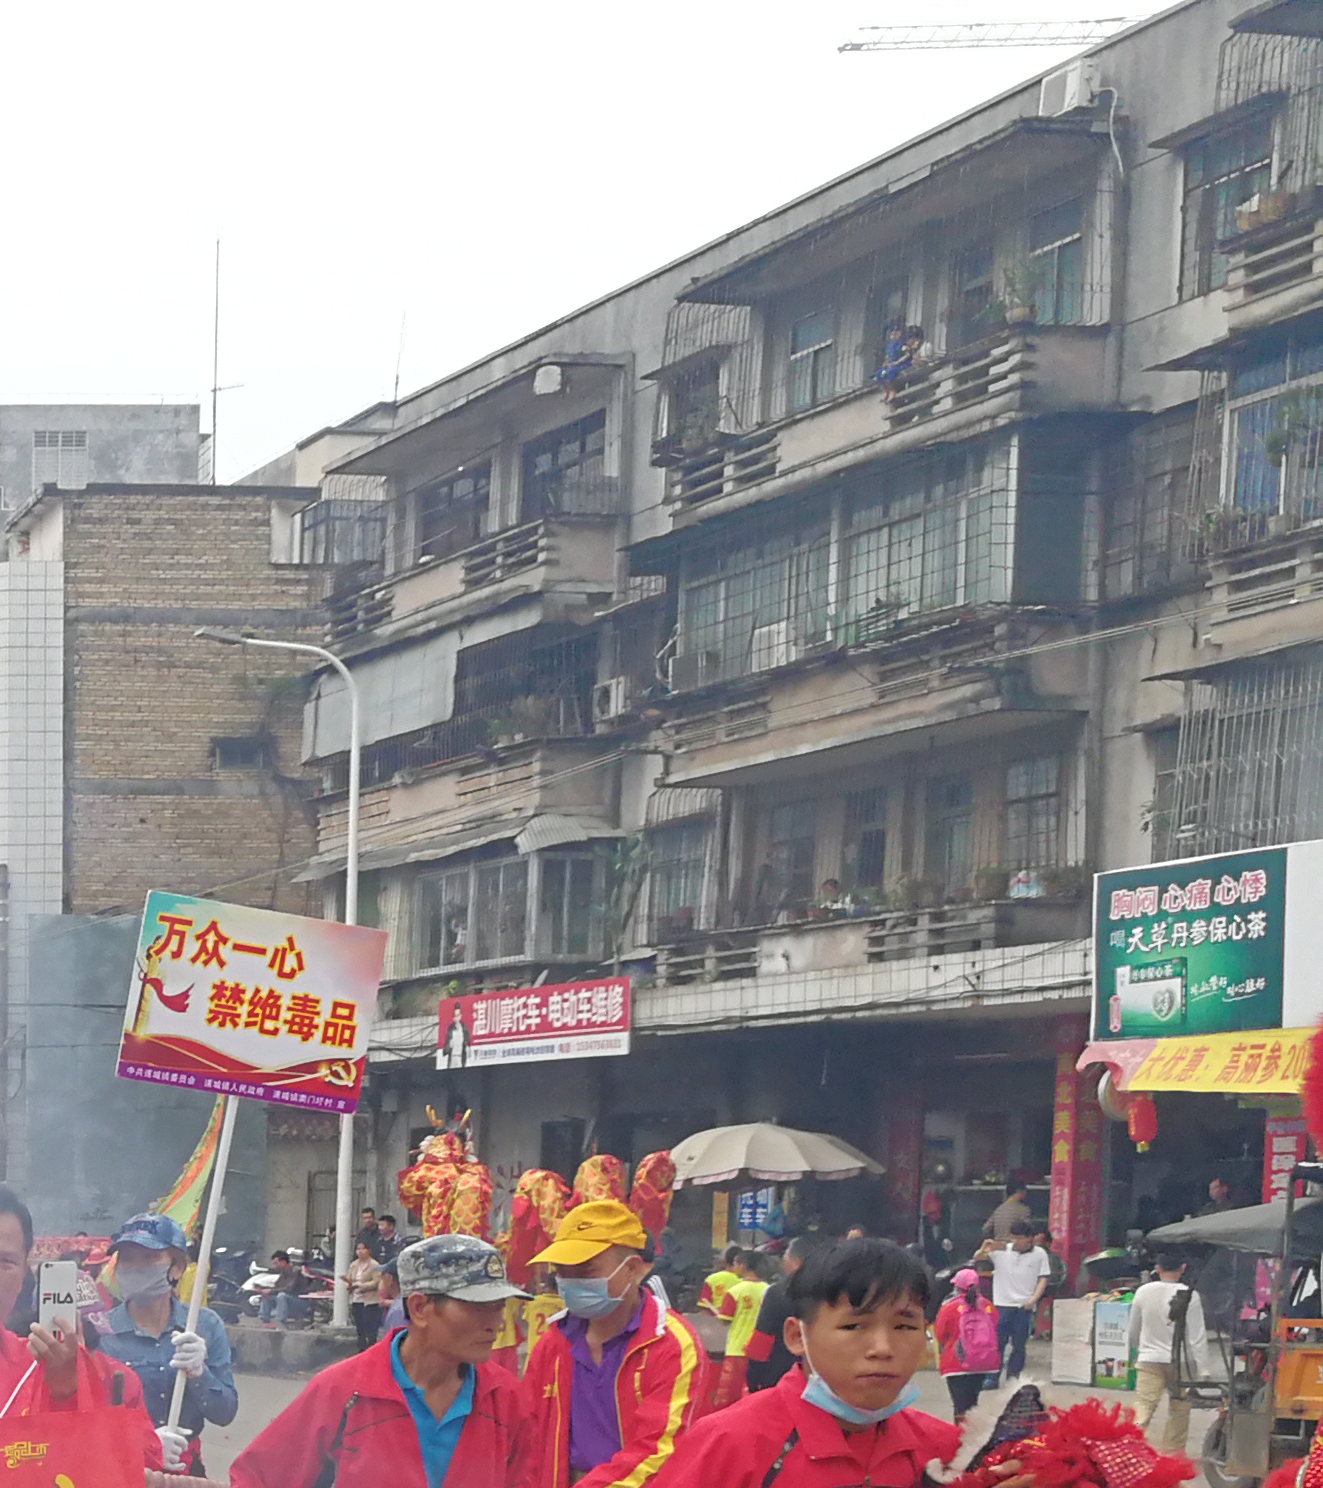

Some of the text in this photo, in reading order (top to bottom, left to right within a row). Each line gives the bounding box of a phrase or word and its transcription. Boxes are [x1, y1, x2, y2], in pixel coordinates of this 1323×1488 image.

[1109, 869, 1268, 920] 胸闷 心痛 心悸
[154, 912, 306, 980] 万众一心
[205, 980, 358, 1050] 禁绝毒品
[42, 1292, 74, 1305] FILA
